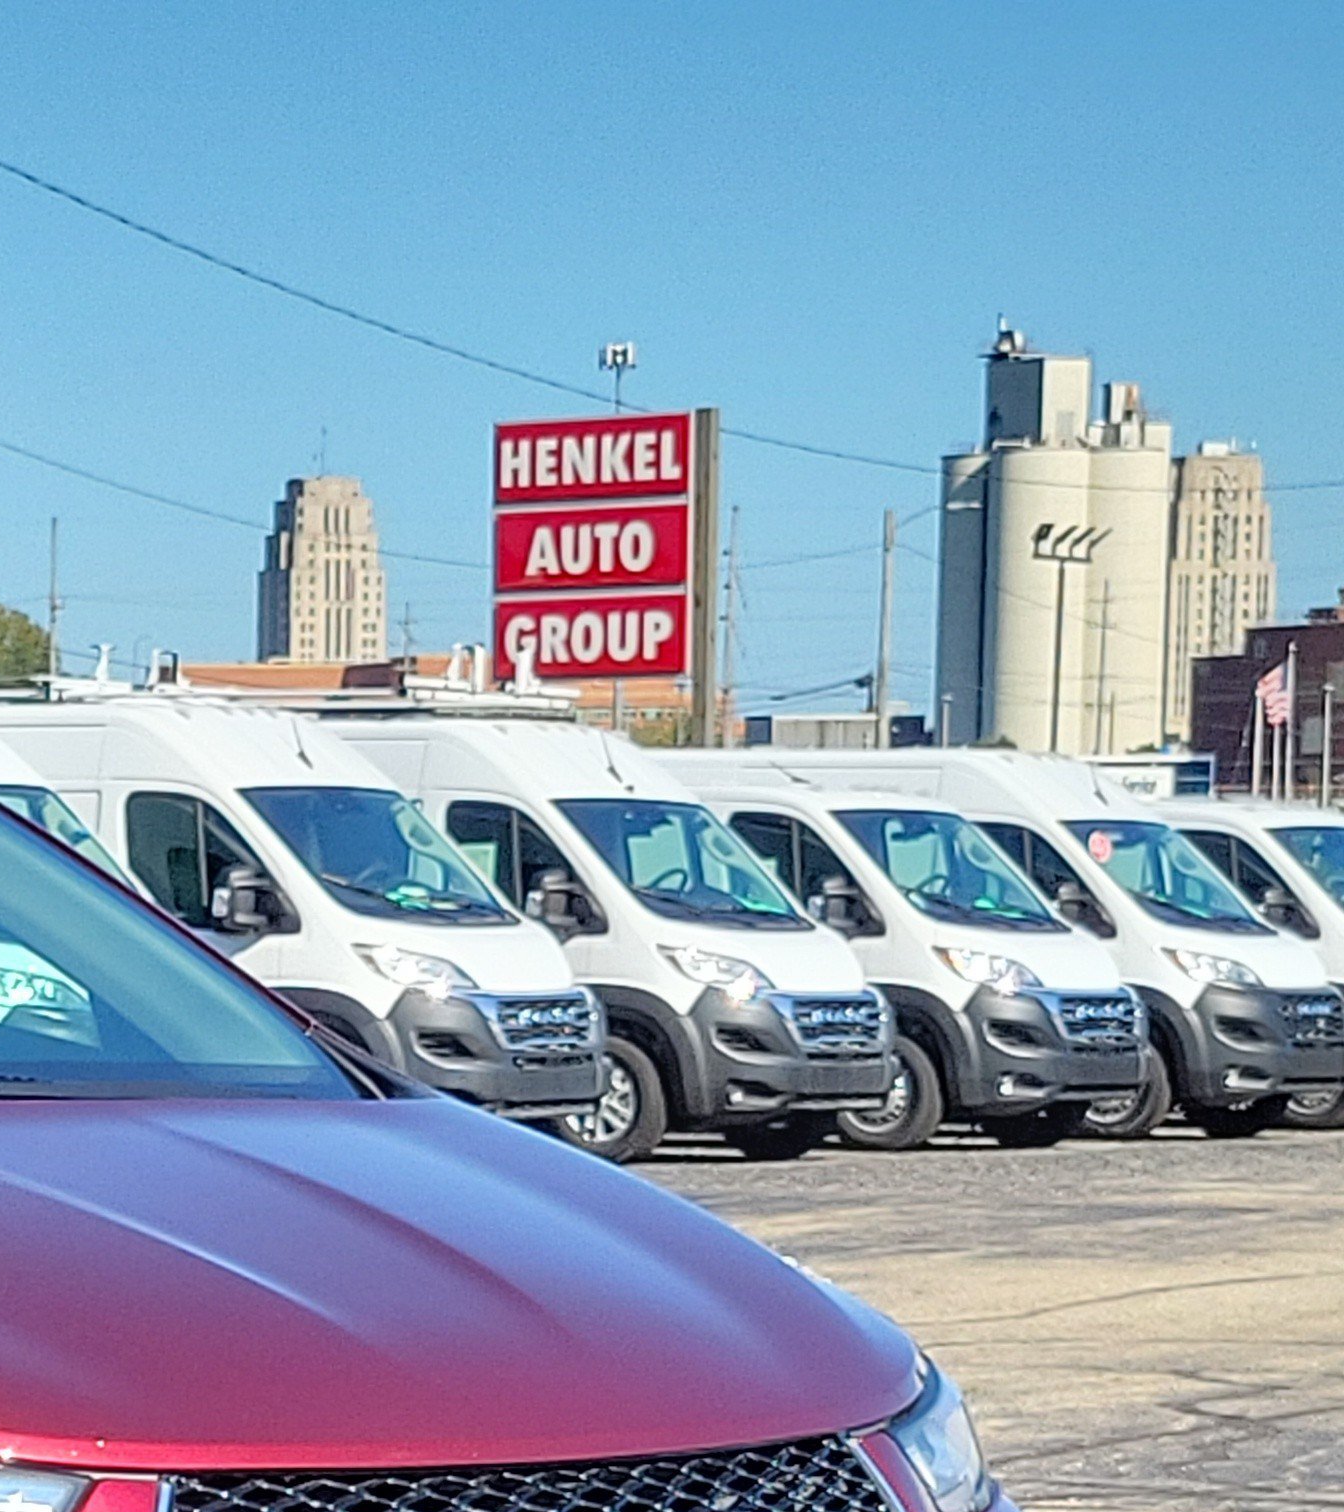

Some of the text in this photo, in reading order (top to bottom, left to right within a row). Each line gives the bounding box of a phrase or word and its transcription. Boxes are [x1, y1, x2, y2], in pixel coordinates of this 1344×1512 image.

[499, 429, 682, 490] HENKEL
[524, 519, 655, 578] AUTO
[503, 609, 674, 665] GROUP
